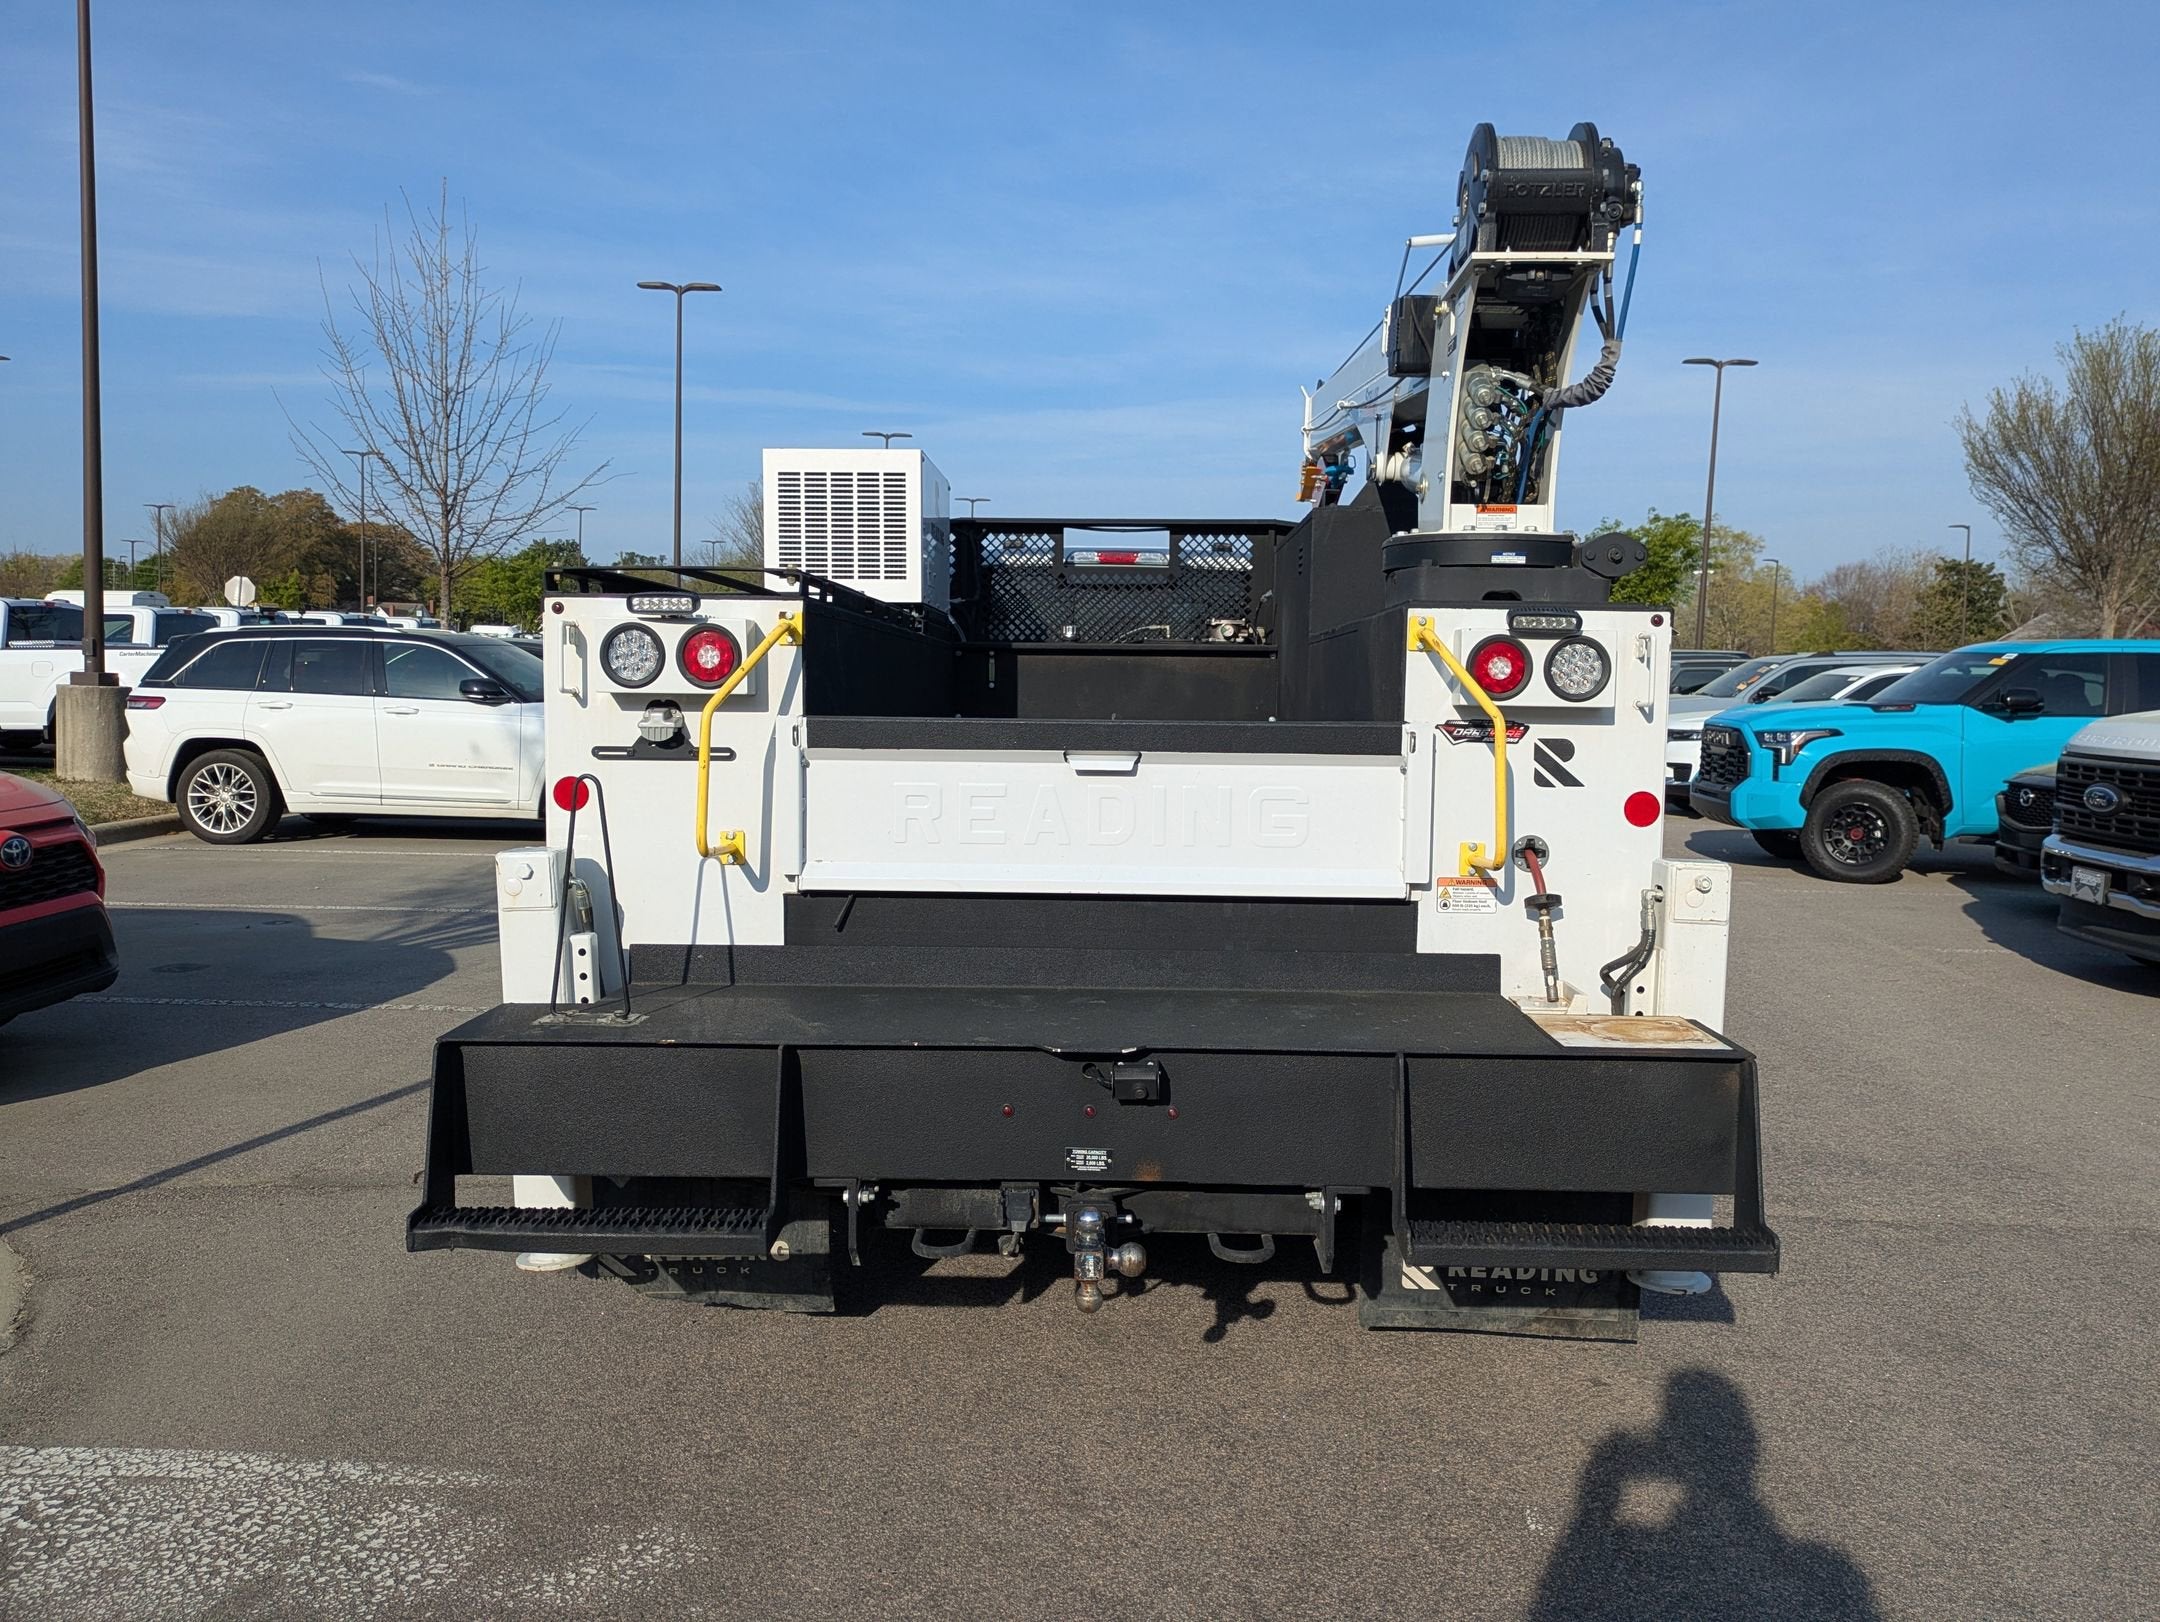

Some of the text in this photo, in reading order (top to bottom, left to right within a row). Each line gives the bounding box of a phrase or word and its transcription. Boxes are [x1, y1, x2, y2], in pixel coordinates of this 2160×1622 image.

[1504, 182, 1585, 199] ROTZLER
[892, 782, 1310, 848] READING
[644, 1267, 751, 1276] TRUCK
[1448, 1283, 1556, 1296] TRUCK
